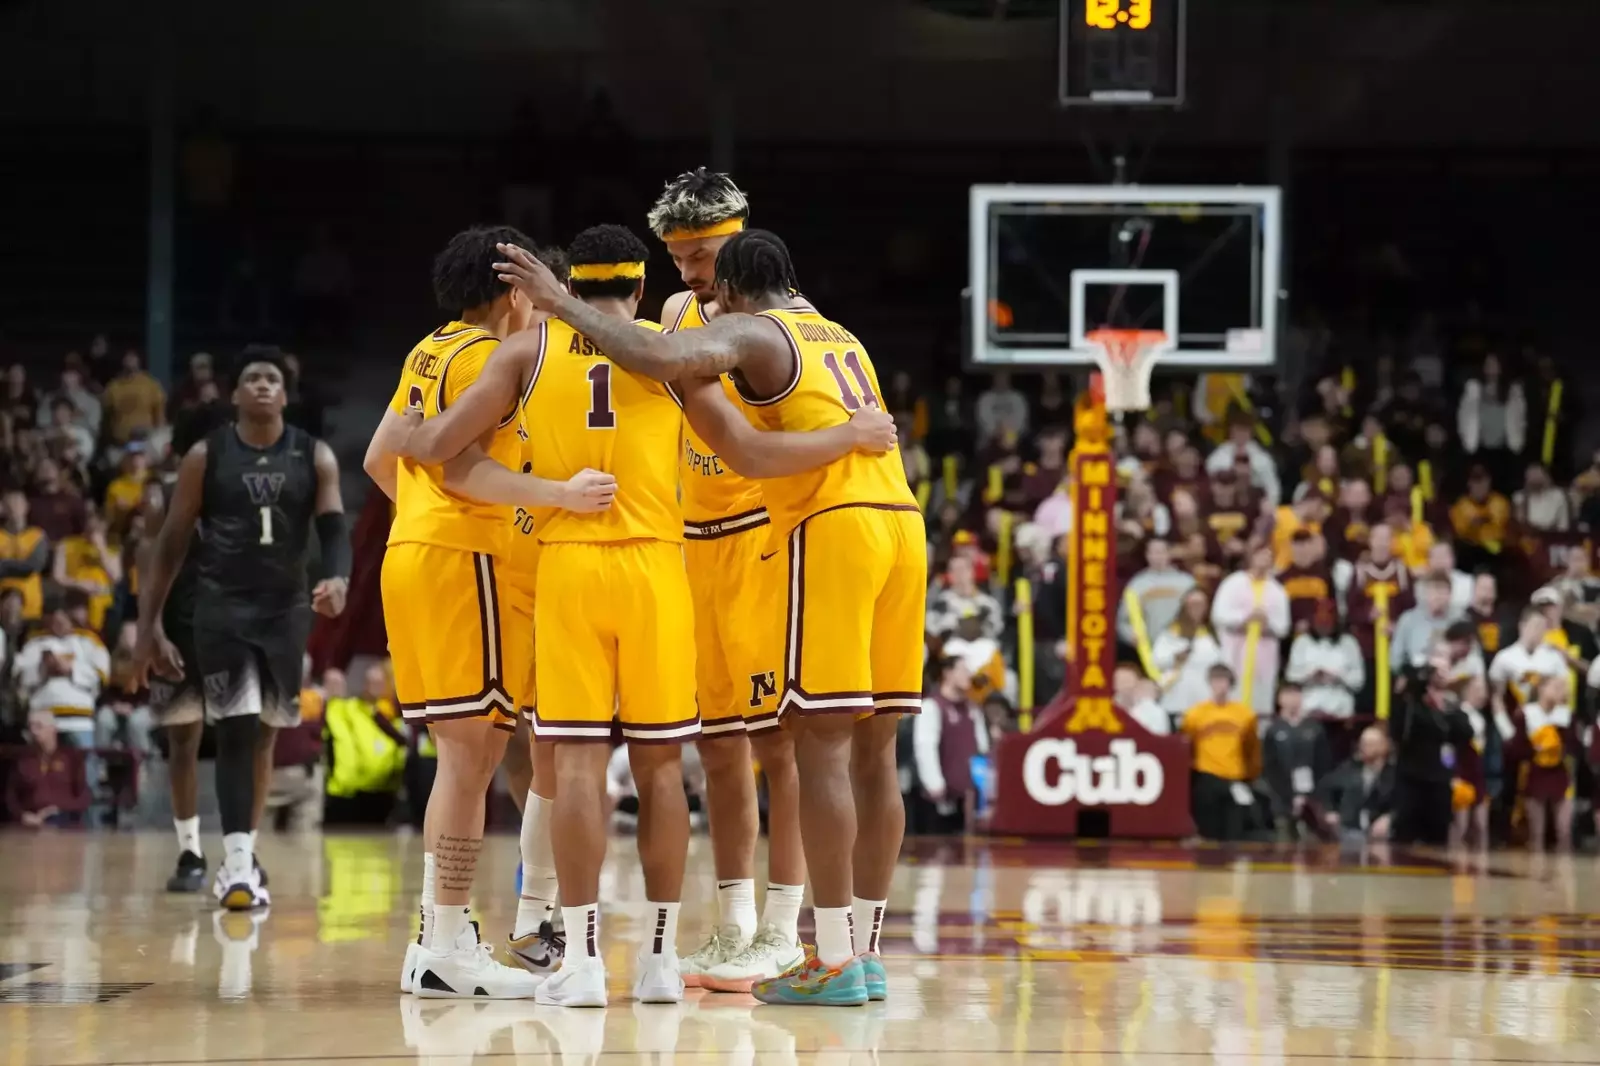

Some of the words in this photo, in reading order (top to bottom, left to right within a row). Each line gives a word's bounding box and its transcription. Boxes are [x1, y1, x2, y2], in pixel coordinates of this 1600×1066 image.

[587, 362, 616, 430] 1
[823, 350, 880, 410] 11
[242, 472, 286, 505] W
[260, 506, 274, 545] 1
[1082, 460, 1108, 688] MINNESOTA
[1022, 737, 1165, 806] Cub
